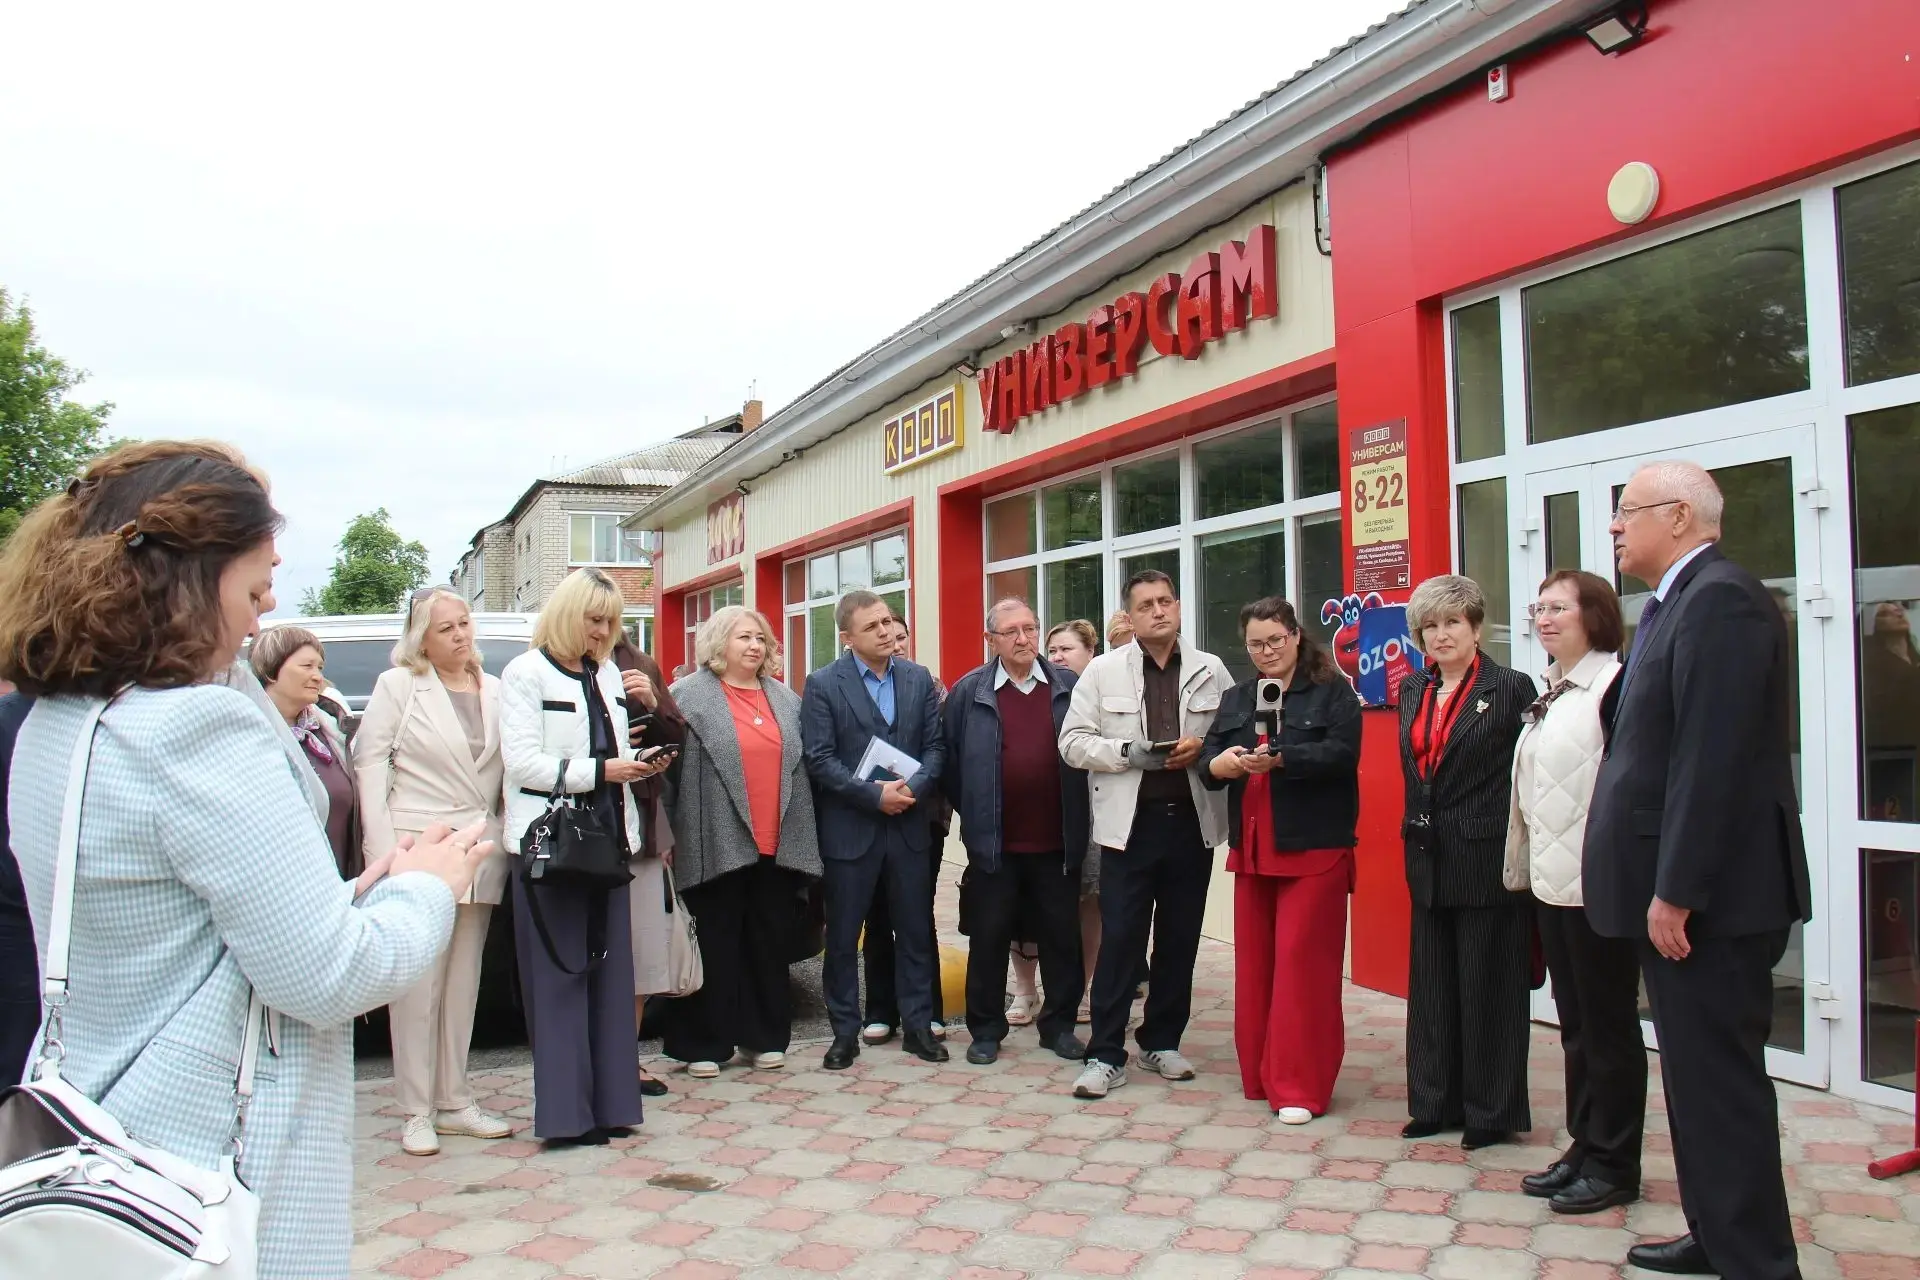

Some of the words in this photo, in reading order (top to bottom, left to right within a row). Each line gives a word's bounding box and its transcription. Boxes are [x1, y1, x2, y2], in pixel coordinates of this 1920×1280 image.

[977, 224, 1277, 434] УНИВЕРСАМ
[886, 400, 951, 463] КООП
[1352, 440, 1404, 461] УНИВЕРСАМ
[1377, 465, 1394, 474] РАБОТЫ
[1355, 472, 1404, 513] 8-22
